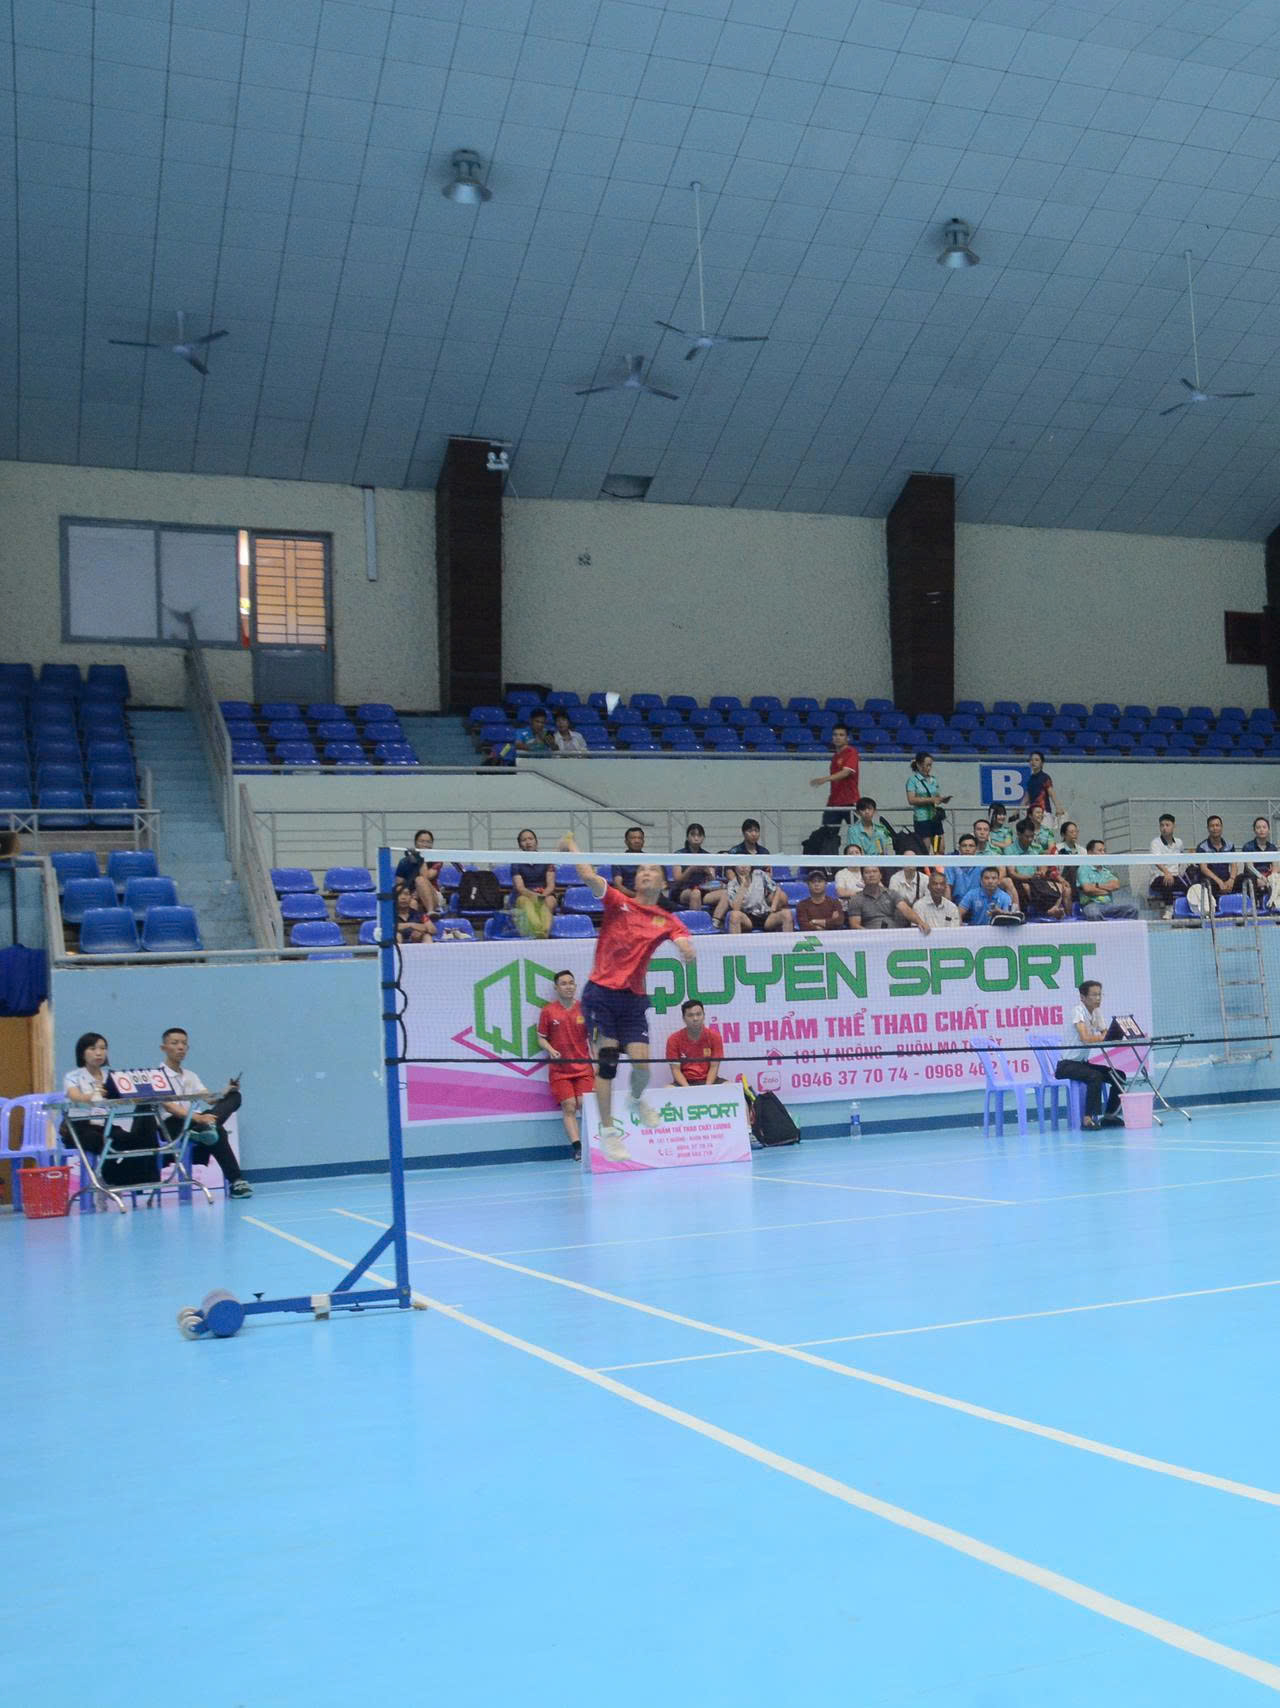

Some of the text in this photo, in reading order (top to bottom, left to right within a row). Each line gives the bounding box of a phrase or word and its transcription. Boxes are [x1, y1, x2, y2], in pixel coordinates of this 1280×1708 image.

[992, 769, 1025, 801] B
[887, 943, 1096, 997] SPORT
[709, 1003, 1064, 1043] ẢN PHẨM THỂ THAO CHẤT LƯỢNG
[792, 1072, 833, 1088] 0946
[838, 1070, 857, 1085] 37
[863, 1068, 883, 1084] 70
[888, 1067, 908, 1082] 74
[925, 1063, 963, 1079] 0968
[1007, 1059, 1029, 1073] 16
[687, 1103, 739, 1120] SPORT
